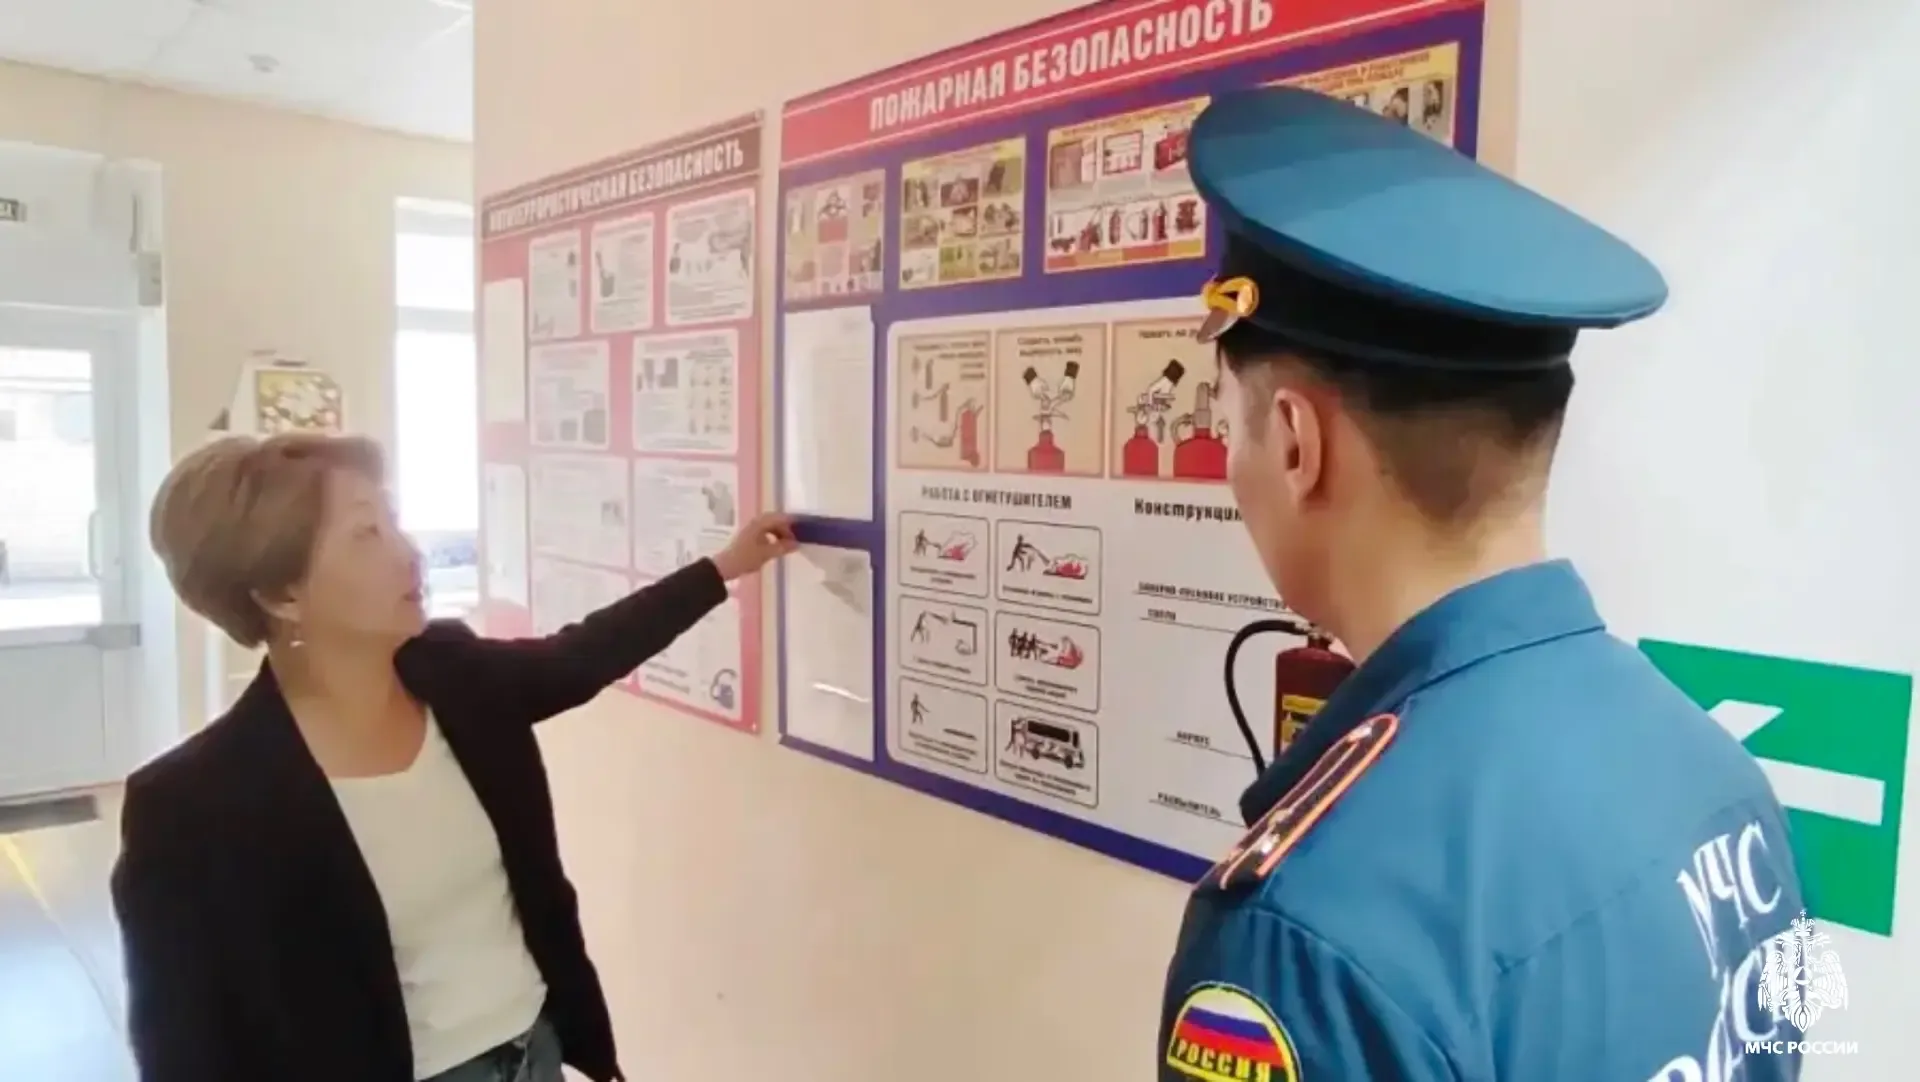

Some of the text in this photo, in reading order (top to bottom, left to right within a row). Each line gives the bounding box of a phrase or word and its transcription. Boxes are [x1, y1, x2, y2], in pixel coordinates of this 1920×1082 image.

[870, 60, 1006, 132] ПОЖАРНАЯ
[1013, 0, 1272, 91] БЕЗОПАСНОСТЬ
[629, 138, 744, 194] БЕЗОПАСНОСТЬ
[921, 485, 961, 501] РАБОТА
[972, 488, 1072, 509] ОГНЕТУШИТЕЛЕМ
[1676, 819, 1782, 981] МЧС
[1176, 1038, 1271, 1082] РОССИЯ
